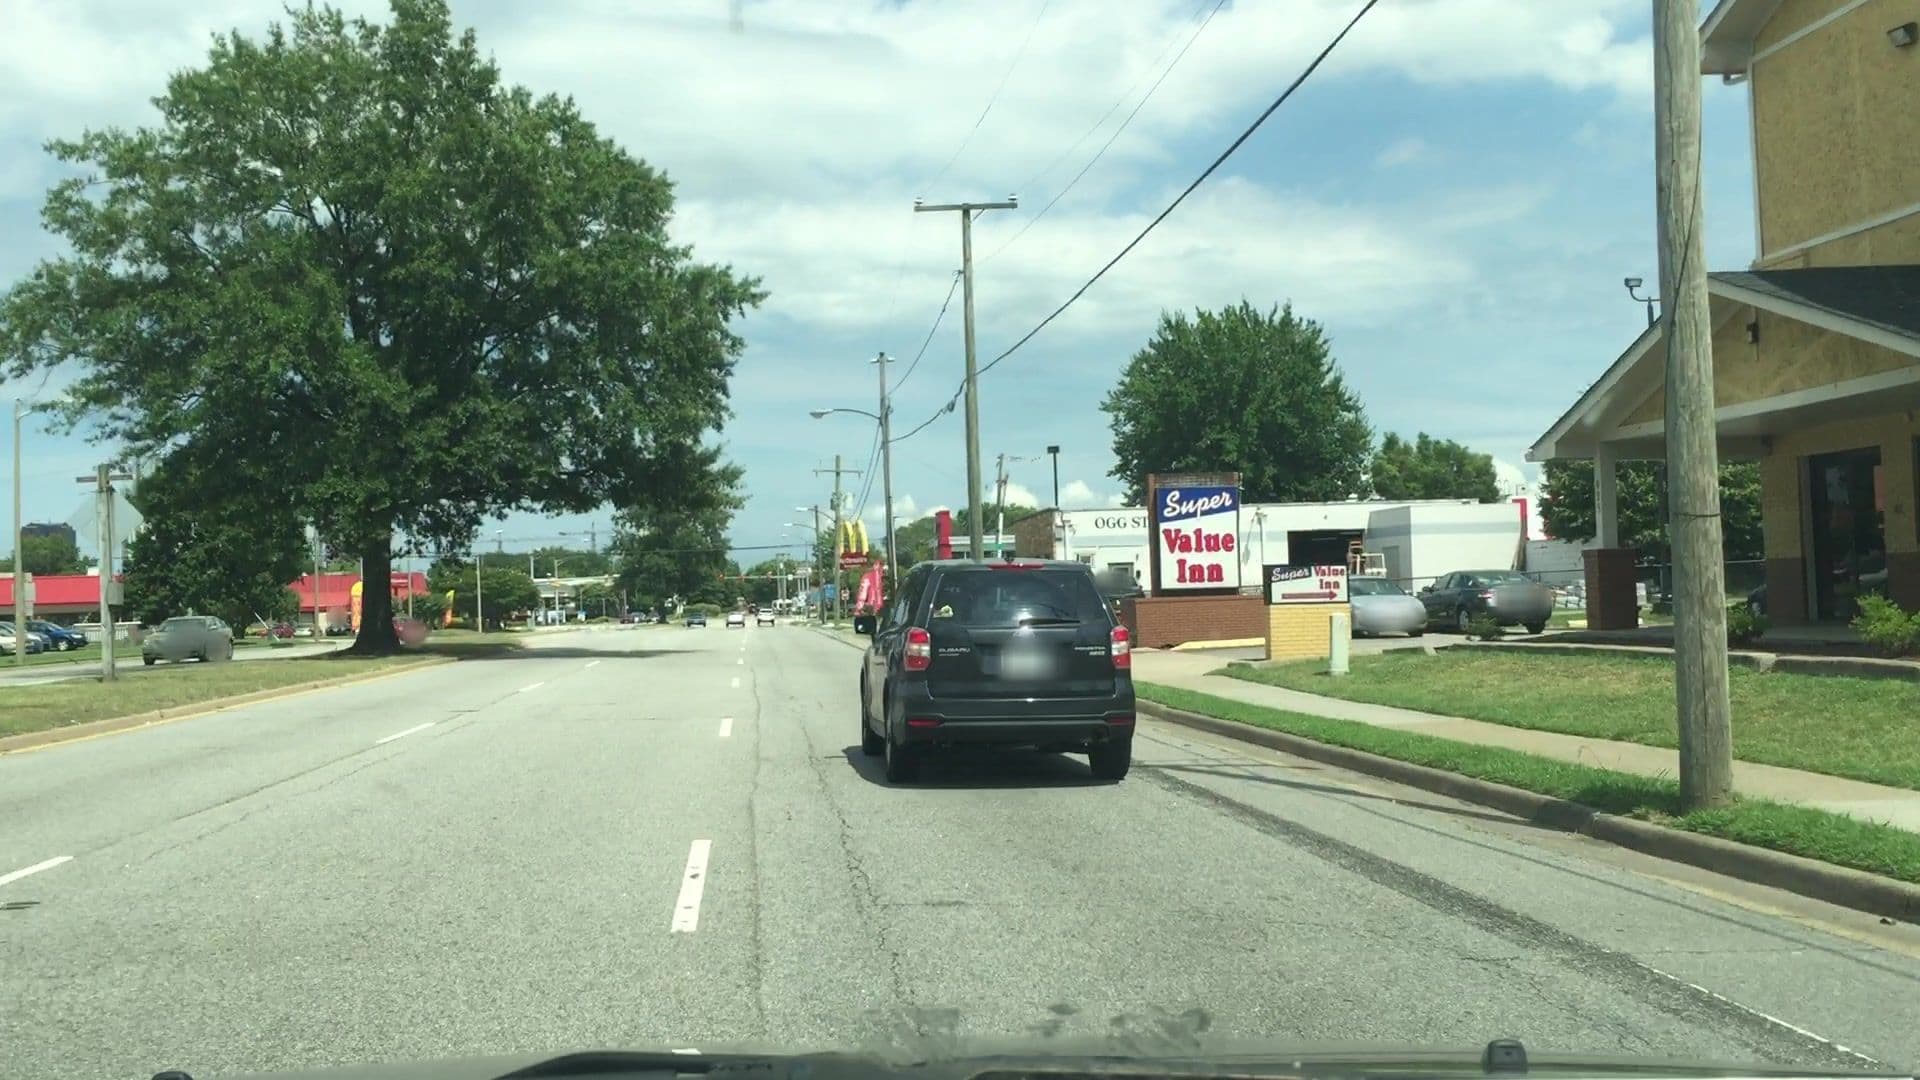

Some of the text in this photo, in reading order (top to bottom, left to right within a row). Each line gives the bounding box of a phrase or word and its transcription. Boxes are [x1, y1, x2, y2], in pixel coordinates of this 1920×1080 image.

[1163, 490, 1232, 519] Super
[1095, 517, 1127, 529] OGG
[1162, 527, 1235, 553] Value
[1176, 559, 1224, 583] Inn
[1271, 566, 1345, 582] Super Value
[1319, 579, 1340, 589] Inn
